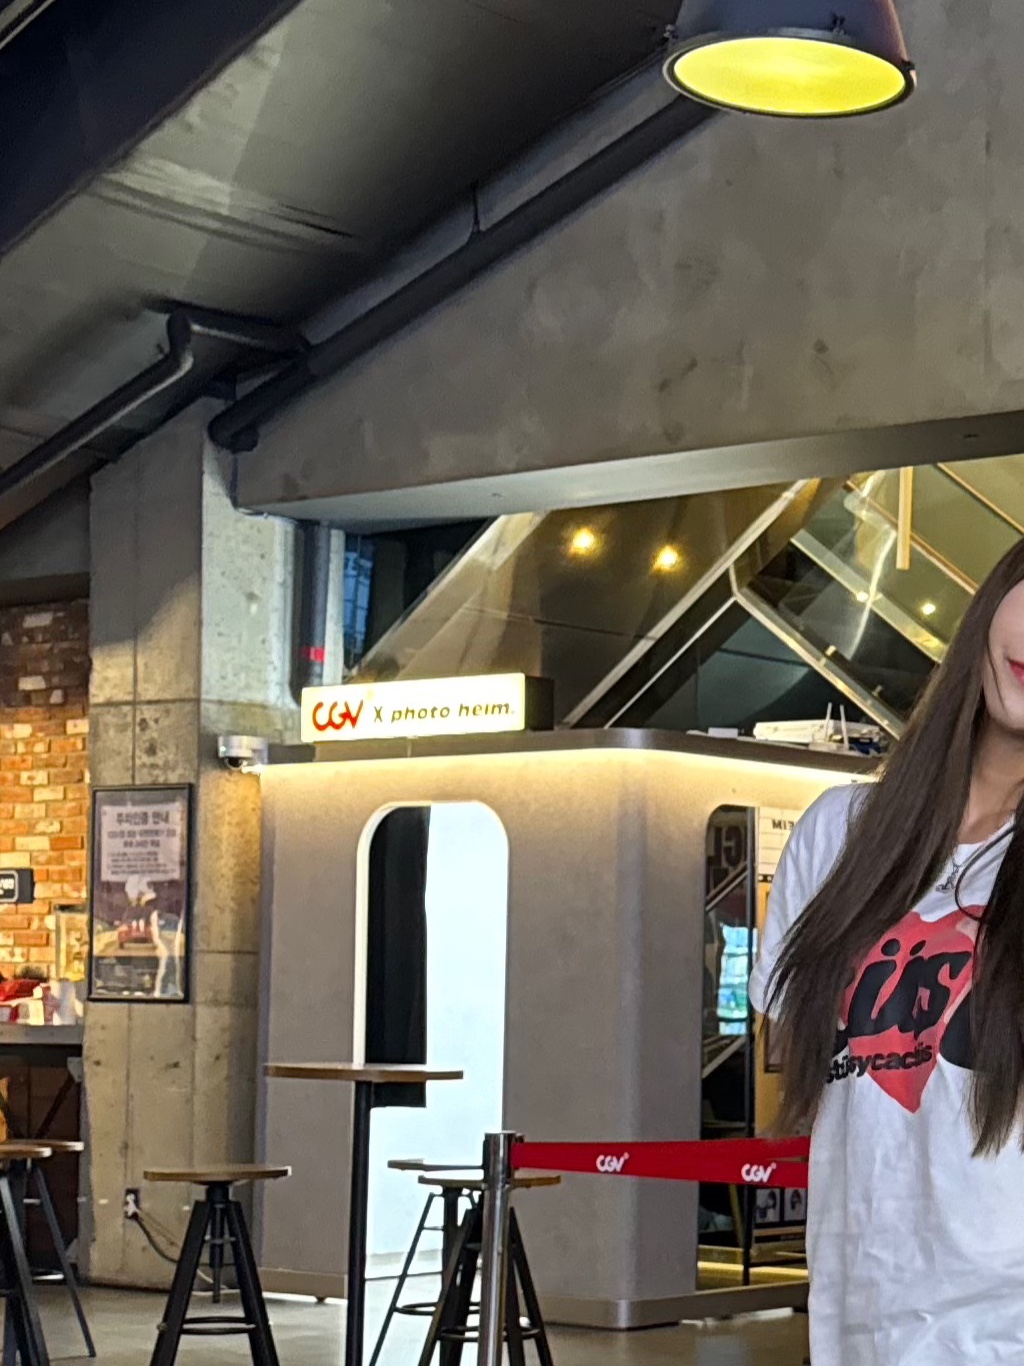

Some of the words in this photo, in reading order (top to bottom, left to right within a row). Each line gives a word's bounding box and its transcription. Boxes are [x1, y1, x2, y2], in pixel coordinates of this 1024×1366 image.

[312, 699, 364, 731] CGV
[391, 706, 451, 724] photo
[596, 1154, 625, 1173] CGV
[741, 1163, 772, 1183] CGV
